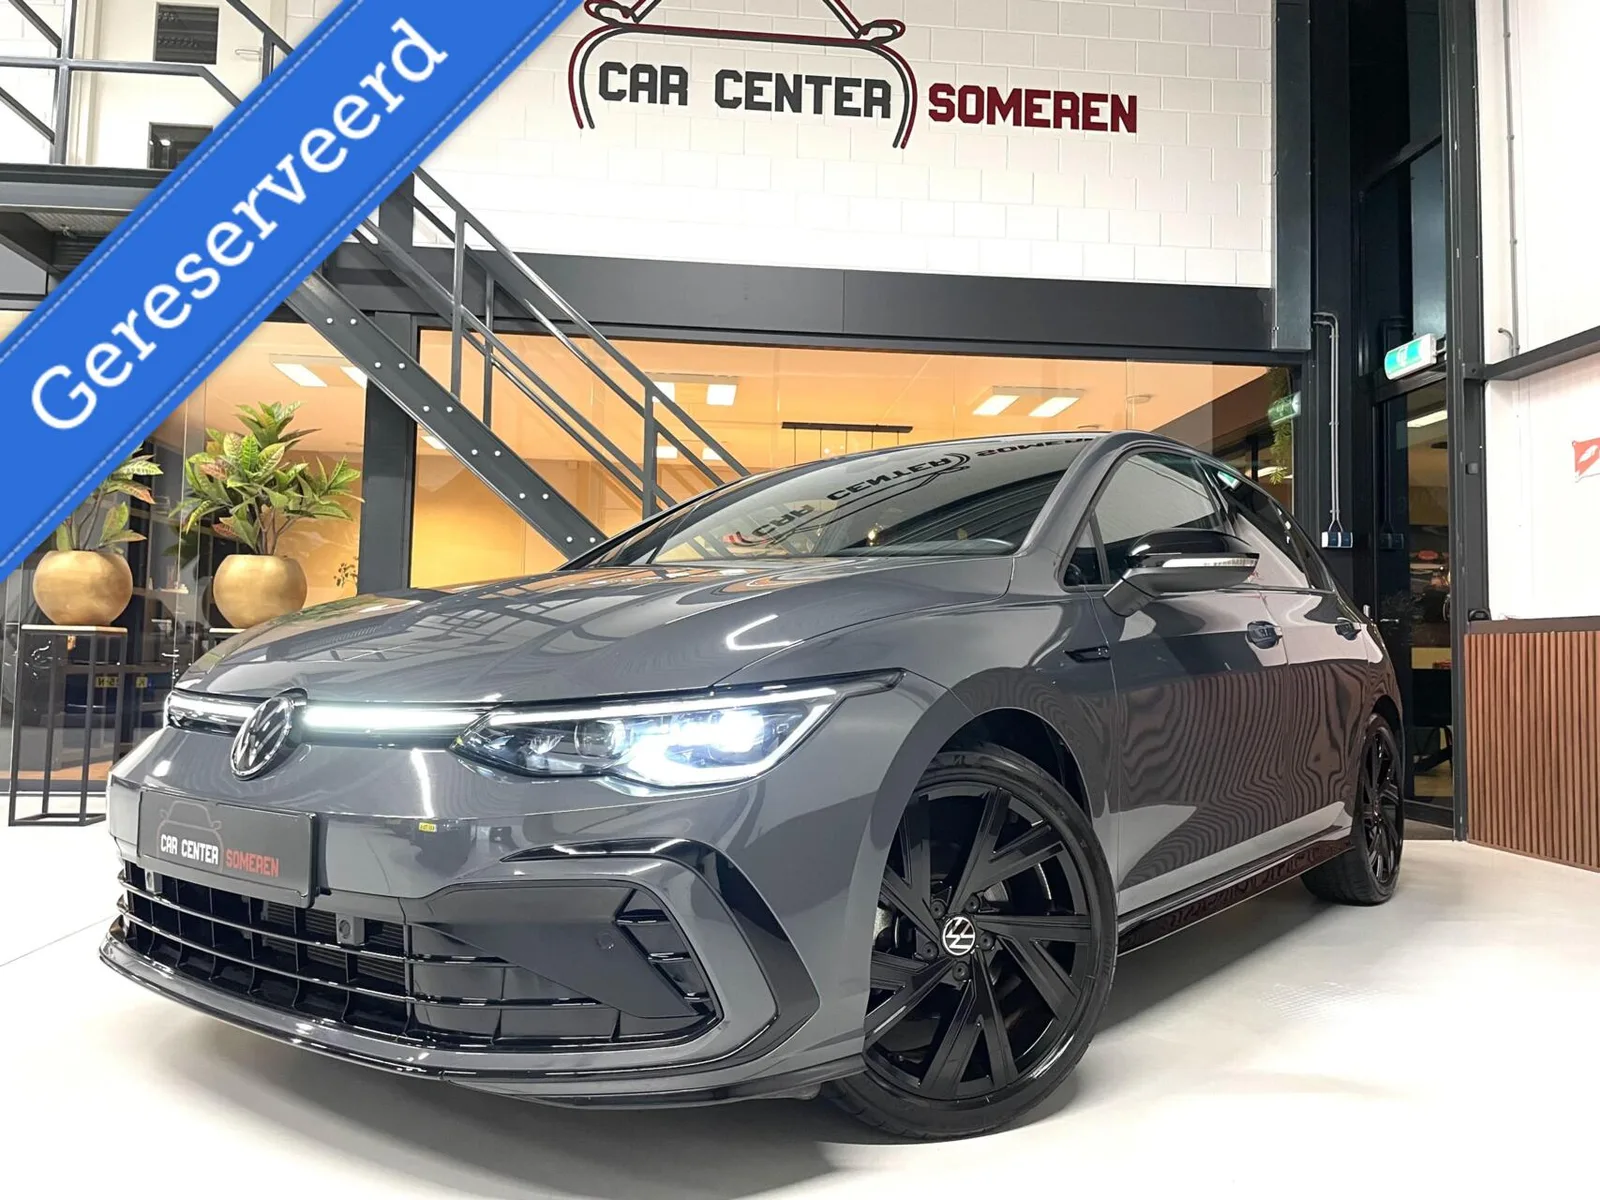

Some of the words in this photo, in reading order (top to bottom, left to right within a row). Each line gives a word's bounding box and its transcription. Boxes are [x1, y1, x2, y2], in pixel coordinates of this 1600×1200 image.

[598, 62, 689, 106] CAR
[714, 69, 892, 119] CENTER
[928, 82, 1138, 134] SOMEREN
[160, 833, 178, 855] CAR
[181, 838, 219, 865] CENTER
[225, 848, 279, 878] SOMEREN
